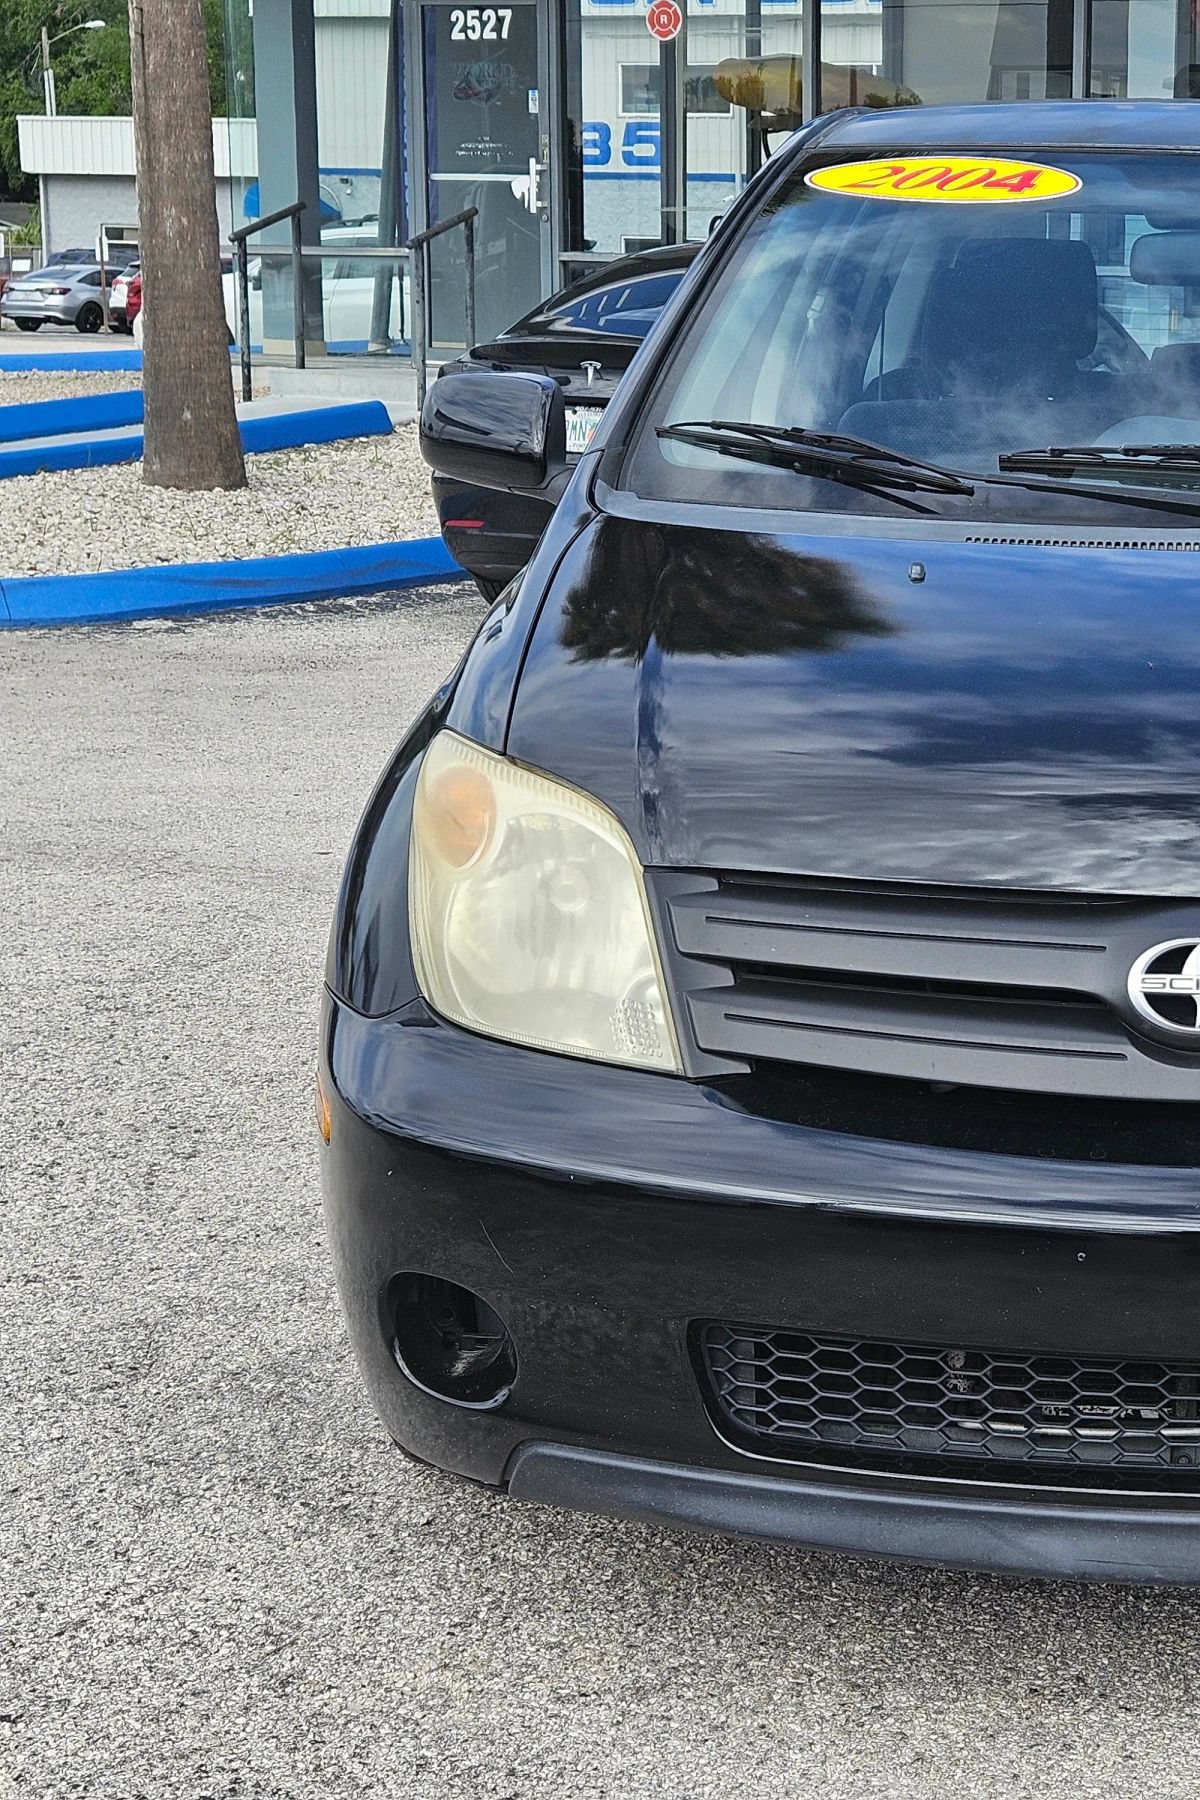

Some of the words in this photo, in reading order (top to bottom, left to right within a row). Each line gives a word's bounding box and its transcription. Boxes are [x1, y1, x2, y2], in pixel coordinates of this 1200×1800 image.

[450, 8, 513, 40] 2527
[659, 14, 669, 25] R
[841, 165, 1045, 193] 2004
